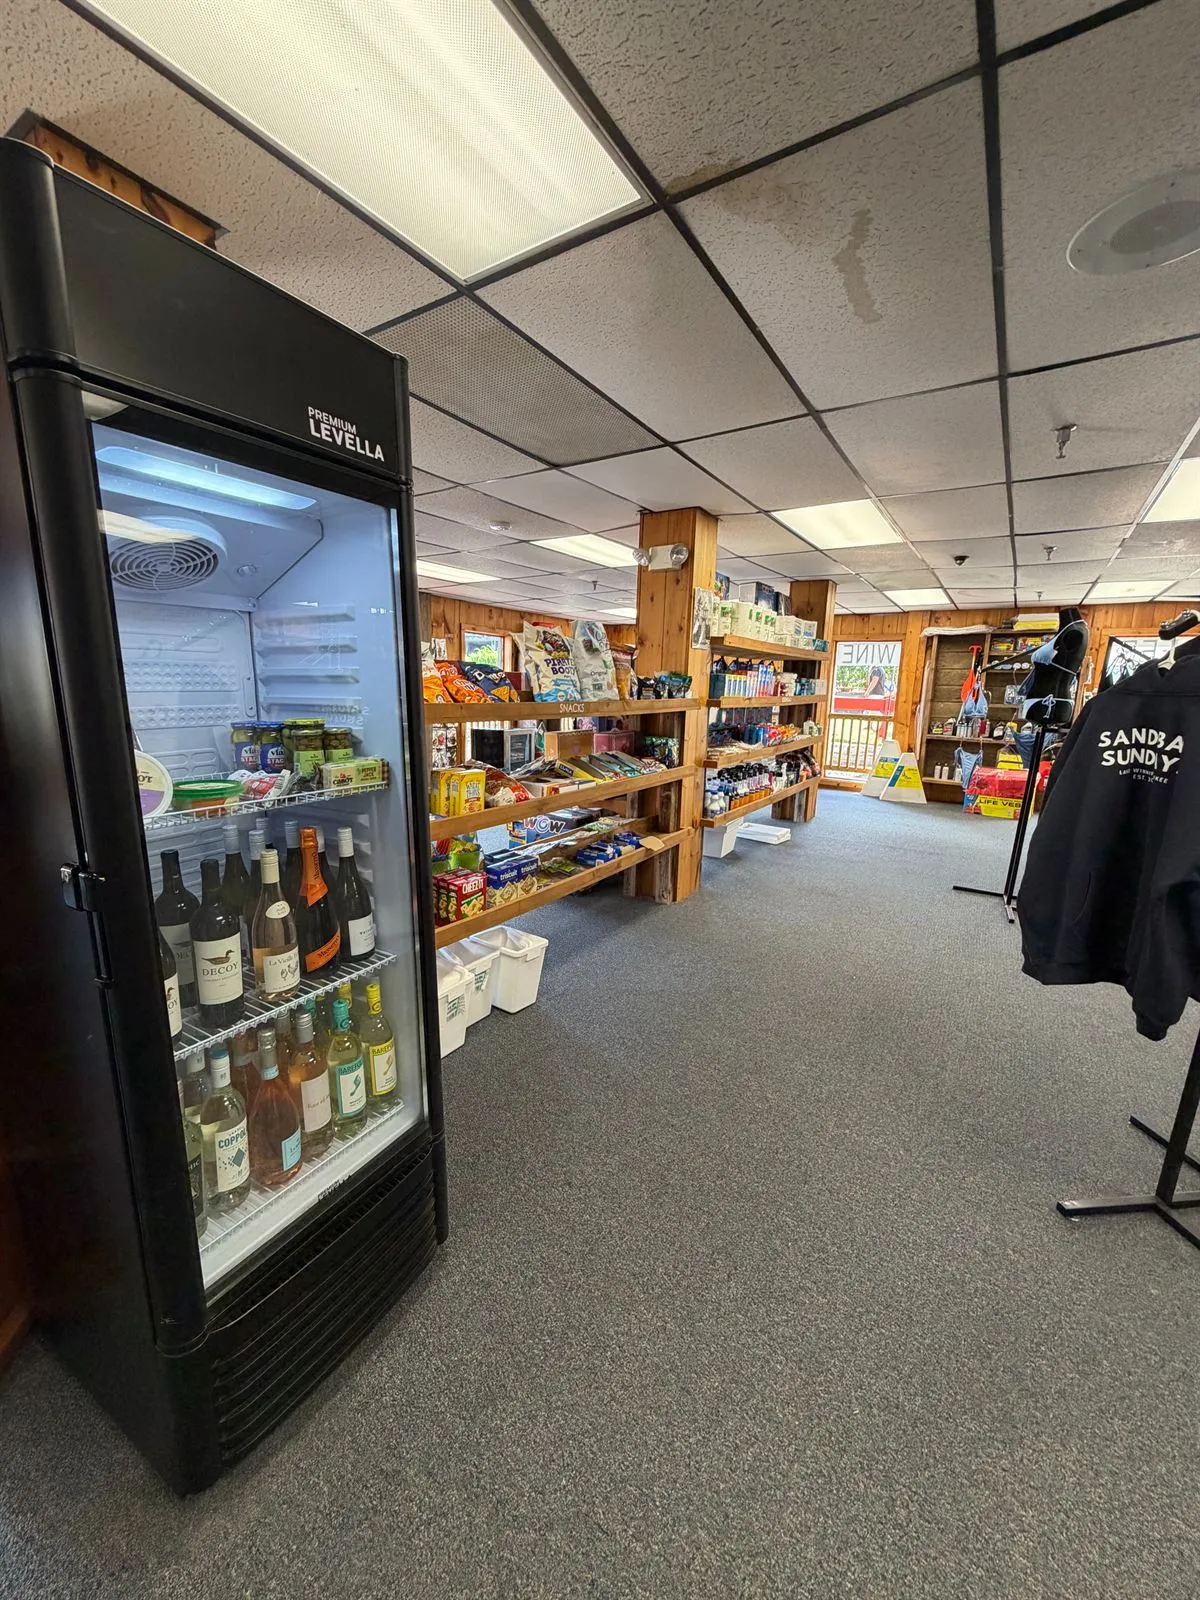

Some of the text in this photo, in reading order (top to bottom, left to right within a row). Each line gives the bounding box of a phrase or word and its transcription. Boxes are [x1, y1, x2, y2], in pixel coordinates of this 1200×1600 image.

[308, 406, 357, 435] PREMIUM
[309, 418, 385, 462] LEVELLA
[544, 658, 575, 668] PIRATE
[559, 703, 585, 713] SNACKS
[1101, 748, 1180, 773] SUNDY
[524, 815, 566, 834] WOW
[500, 869, 518, 881] triscuit
[521, 863, 538, 873] triscuit
[202, 961, 239, 977] DECOY
[218, 1127, 247, 1149] COPPOL
